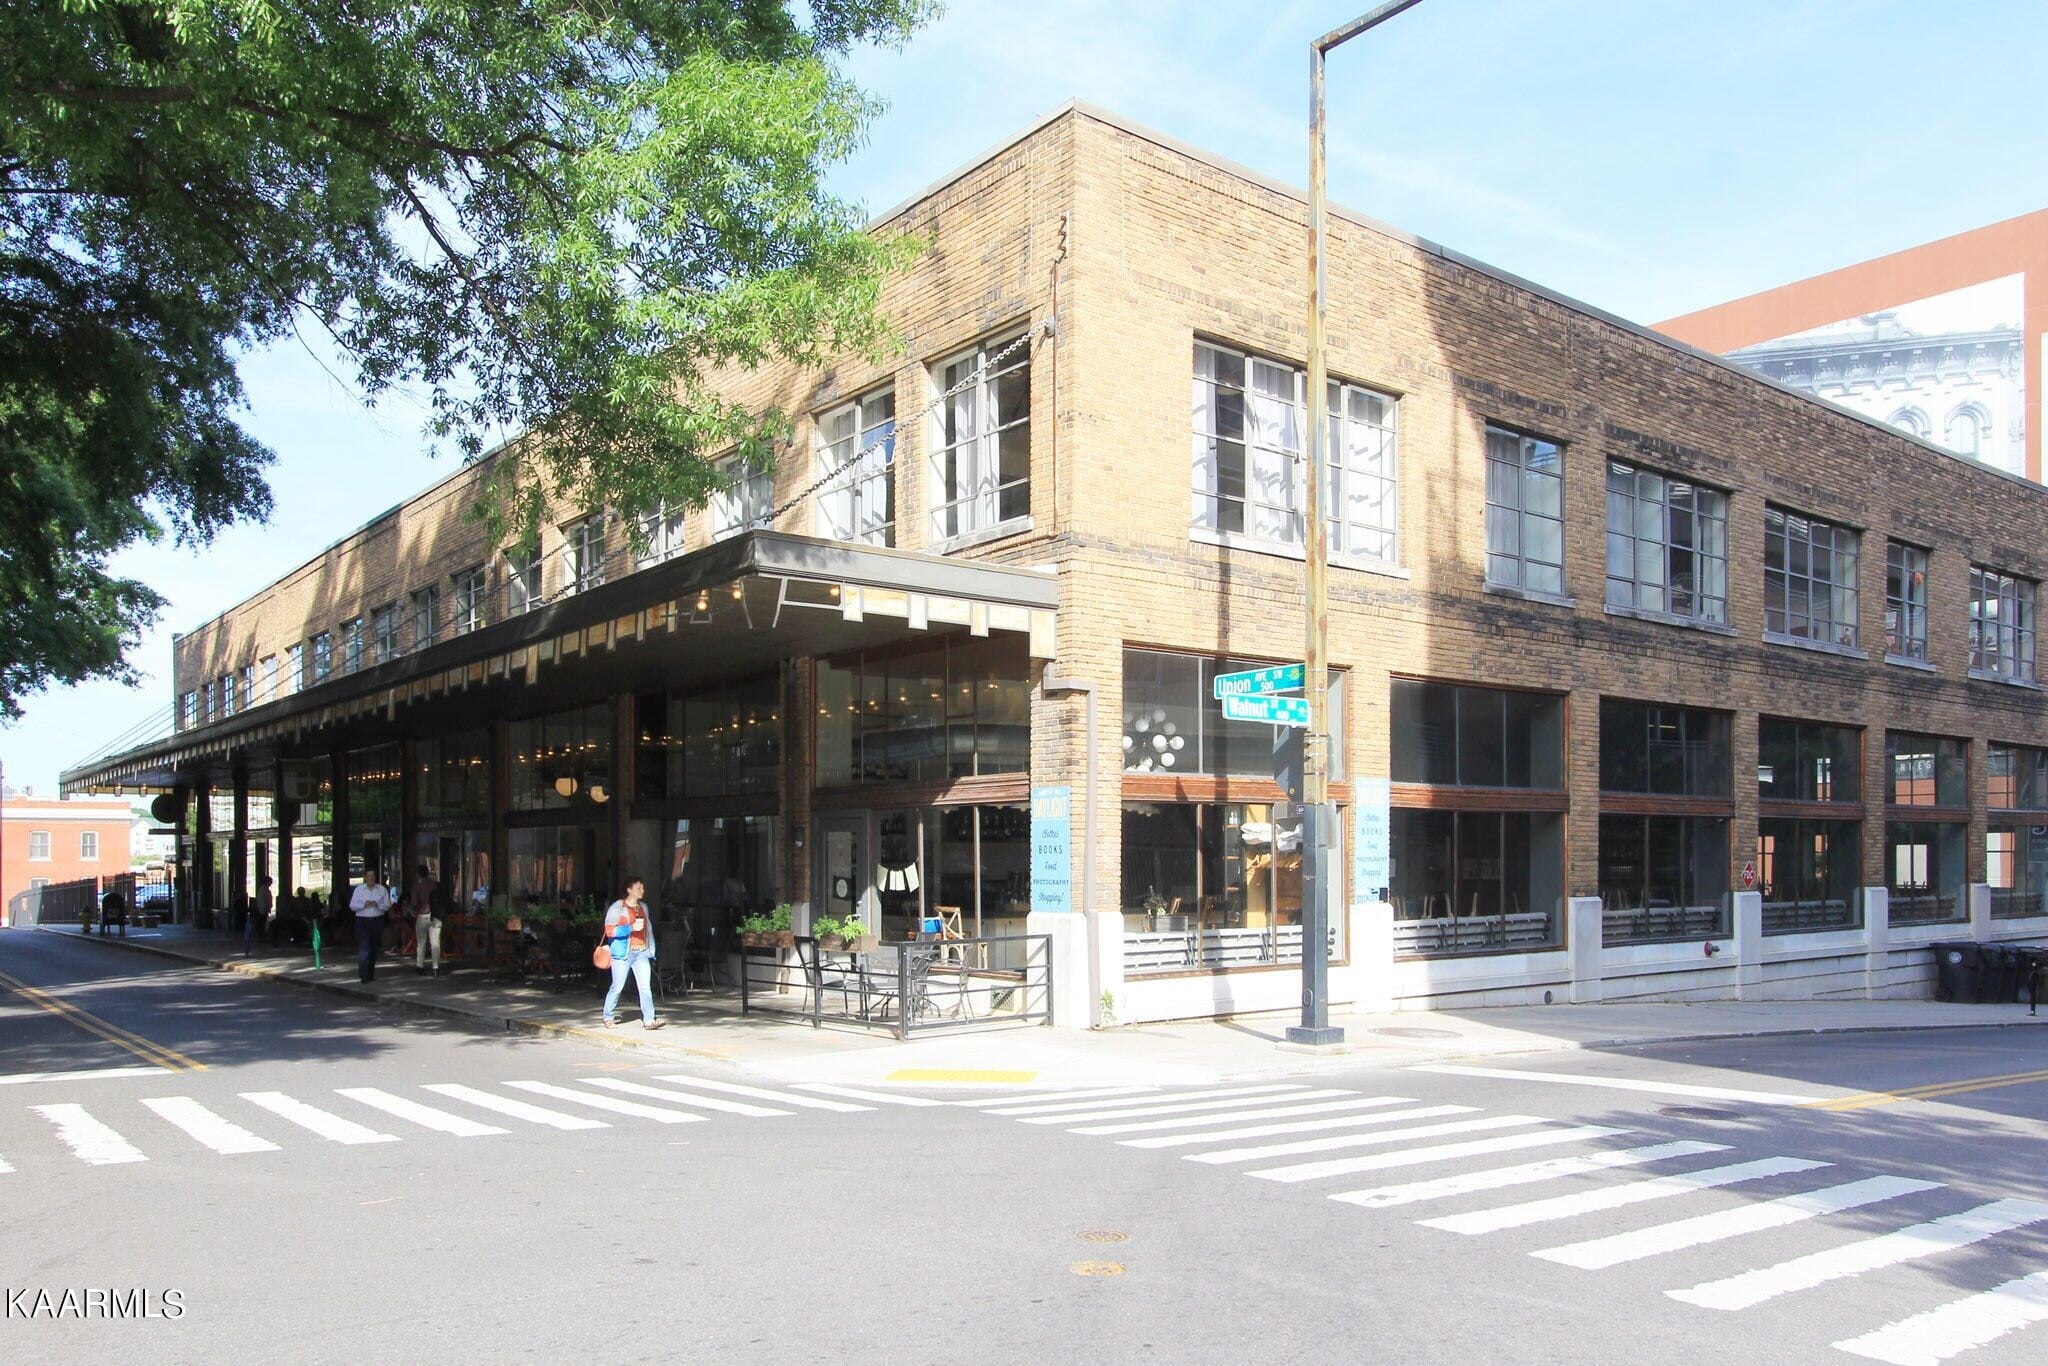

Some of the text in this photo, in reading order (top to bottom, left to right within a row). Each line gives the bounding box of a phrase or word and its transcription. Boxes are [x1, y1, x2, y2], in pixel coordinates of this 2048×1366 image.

[1218, 670, 1283, 694] Union AVE SW
[1260, 682, 1274, 691] 500
[1228, 697, 1269, 717] Walnut
[1038, 845, 1063, 854] BOOKS
